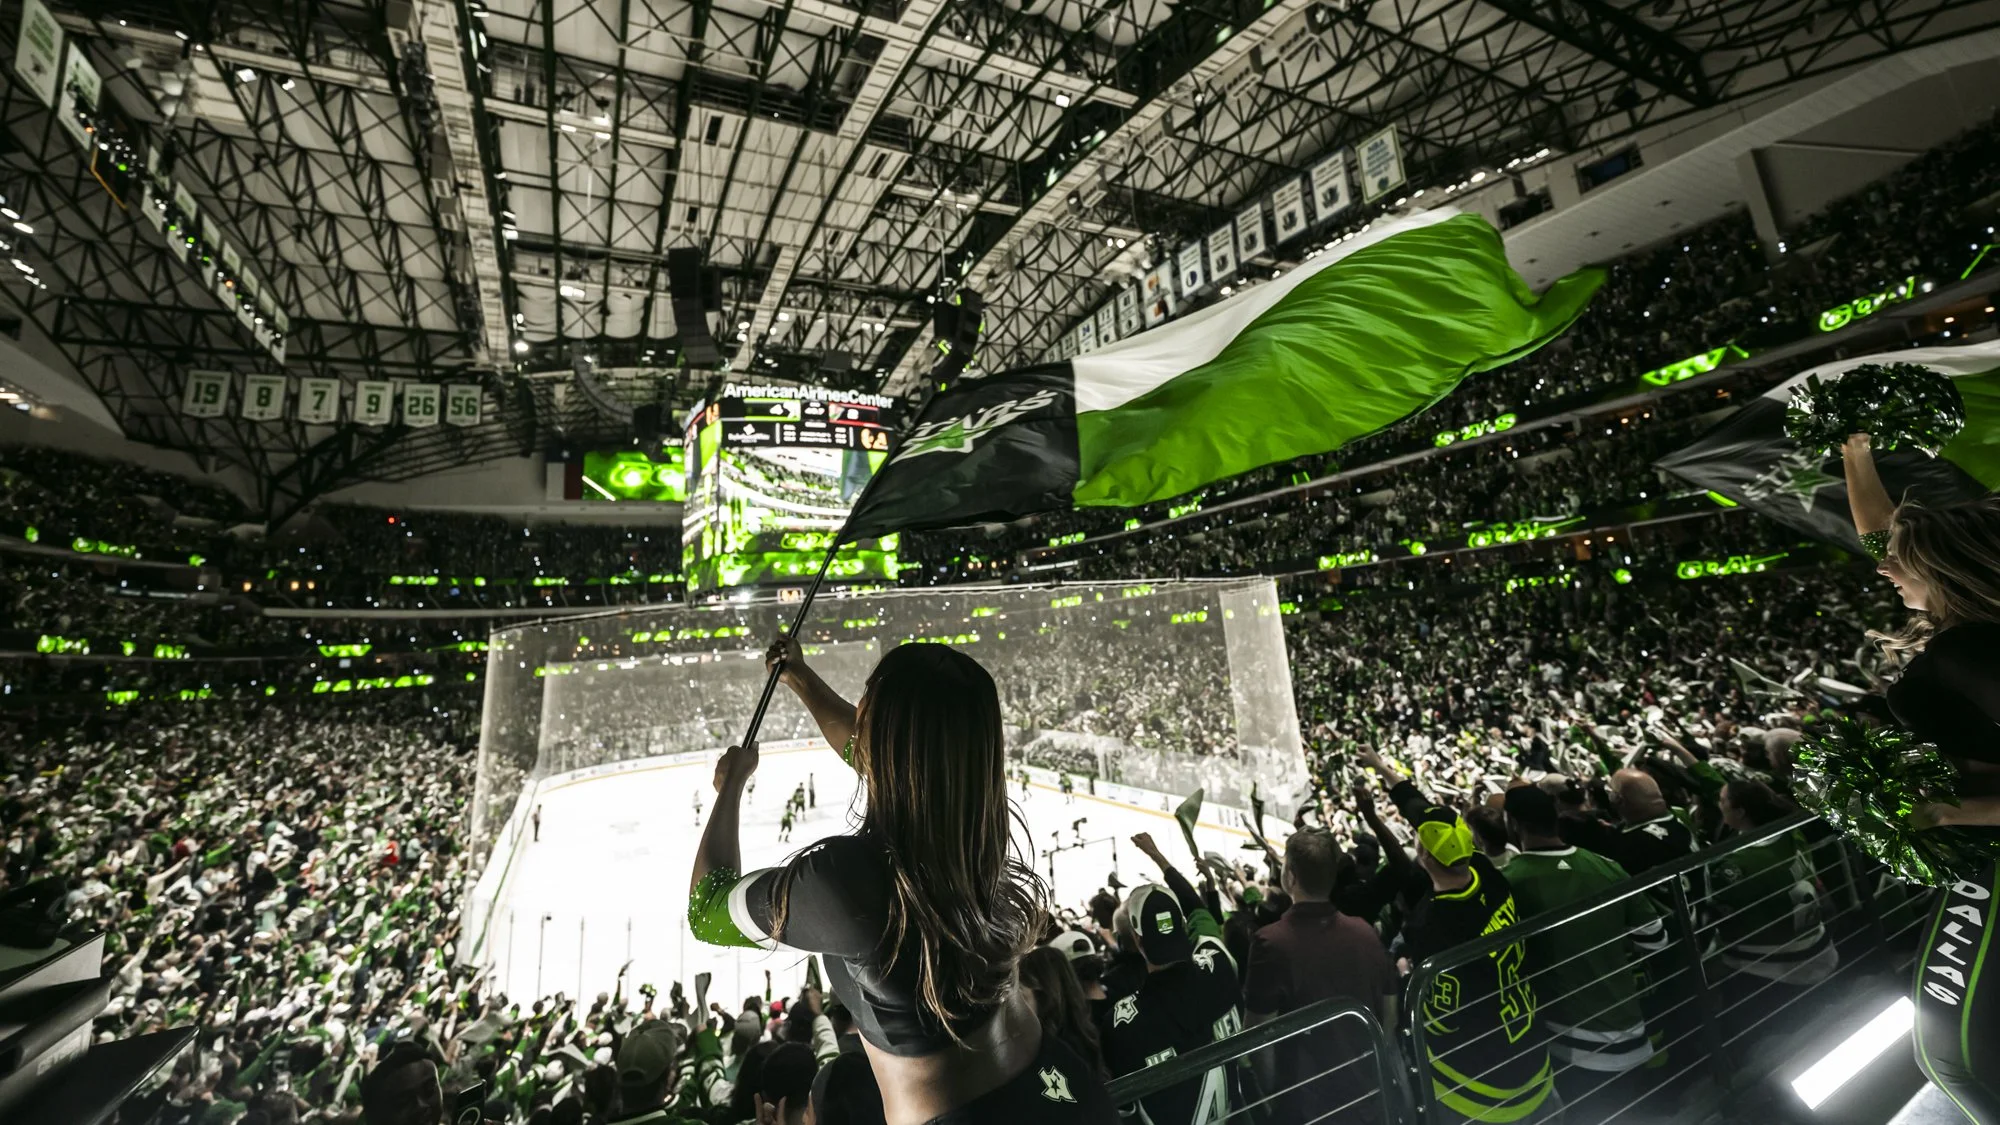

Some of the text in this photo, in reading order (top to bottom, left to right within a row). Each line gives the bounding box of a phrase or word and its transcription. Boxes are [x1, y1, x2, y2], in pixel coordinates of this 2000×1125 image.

[192, 381, 220, 404] 19
[256, 386, 272, 407] 8
[312, 390, 326, 410] 7
[365, 393, 380, 414] 9
[408, 396, 435, 416] 26
[450, 396, 477, 416] 56
[1923, 879, 1991, 1006] DALLAS
